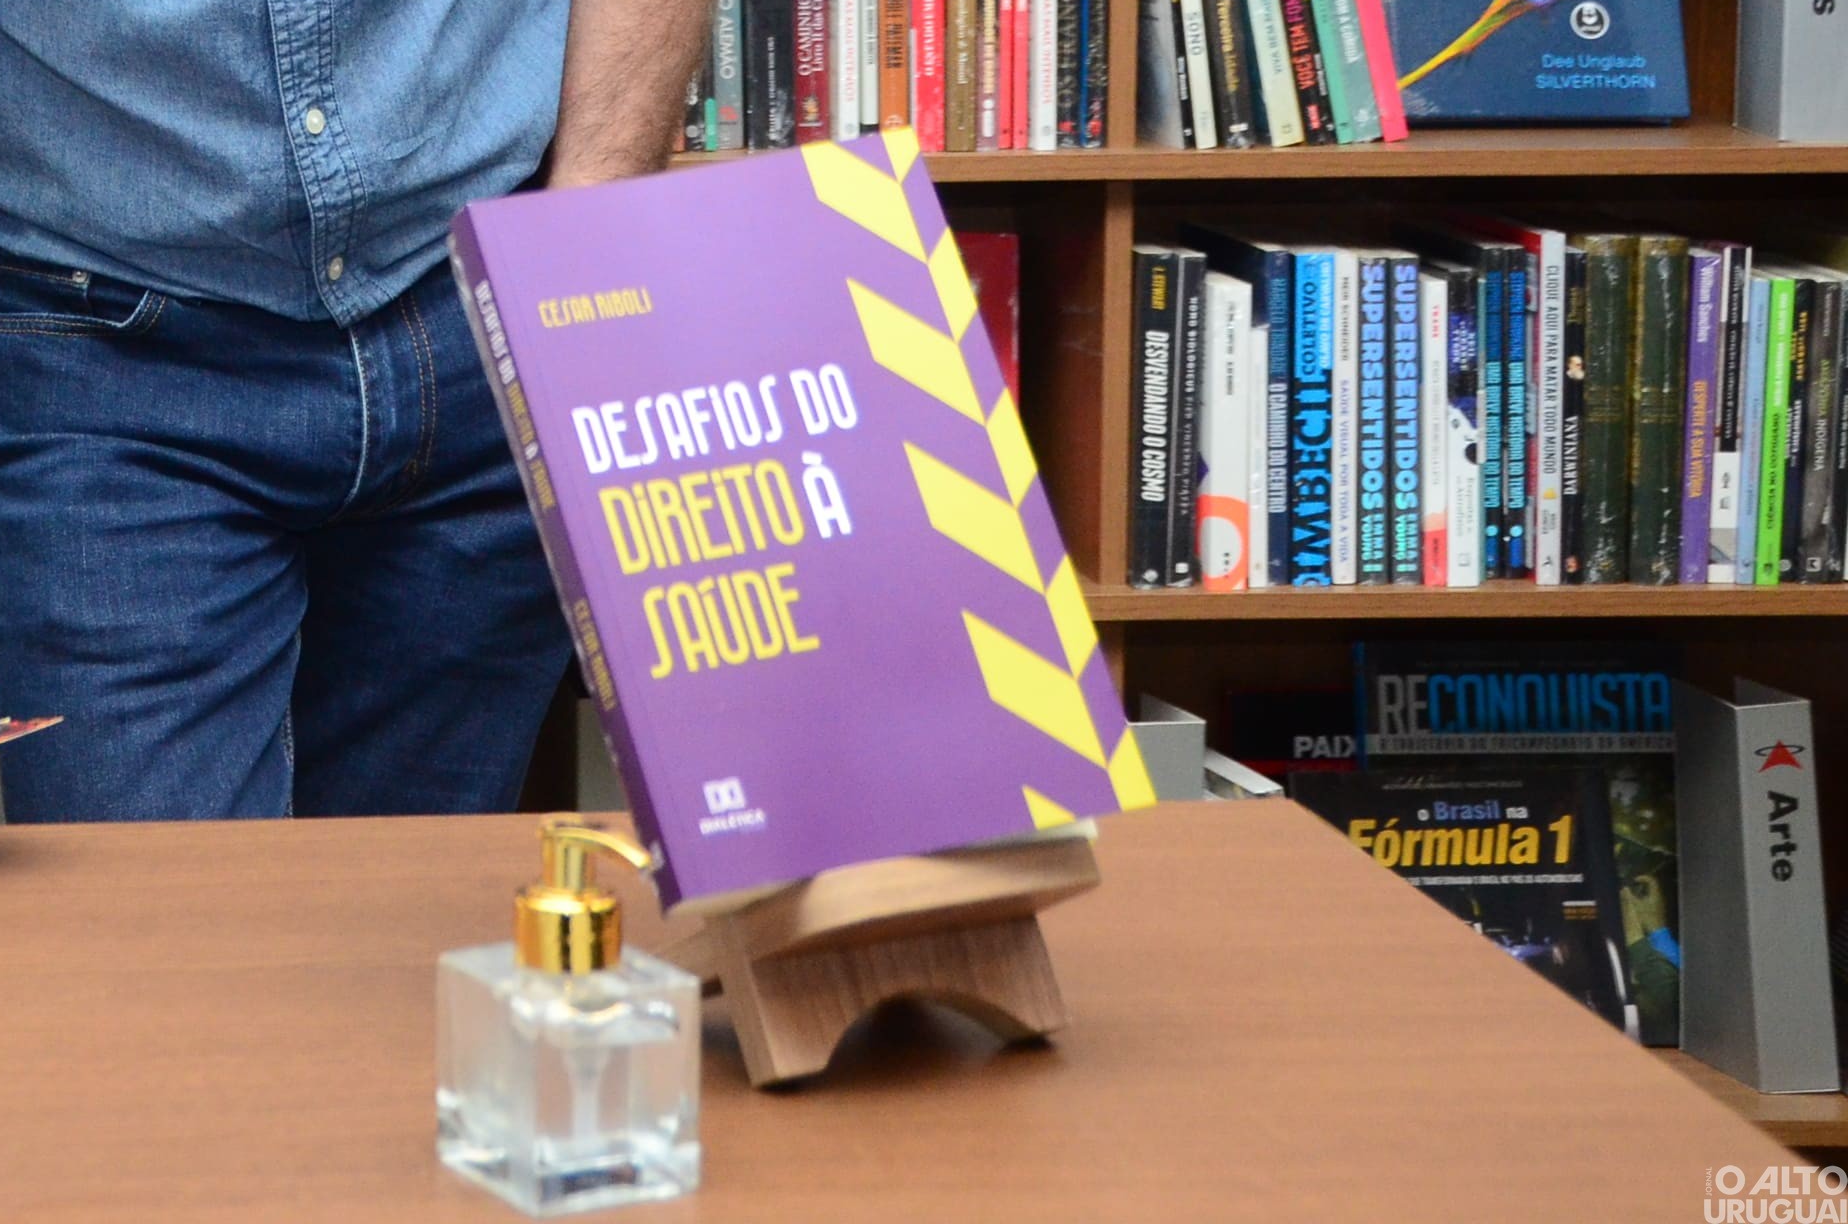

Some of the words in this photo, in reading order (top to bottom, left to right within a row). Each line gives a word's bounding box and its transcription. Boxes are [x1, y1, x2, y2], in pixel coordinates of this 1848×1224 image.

[1535, 74, 1656, 91] SILVERTHORN
[1542, 54, 1574, 69] Dee
[1577, 53, 1646, 72] Unglaub
[1545, 264, 1559, 302] CLIQUE
[538, 295, 594, 328] CESAR
[595, 286, 653, 321] RIBOLI
[1300, 281, 1318, 376] COLETIVO
[1544, 305, 1558, 332] AQUI
[1543, 333, 1558, 364] PARA
[1143, 329, 1170, 435] DESVENDANDO
[1269, 382, 1286, 391] O
[1361, 264, 1386, 510] SUPERSENTIDOS
[1394, 264, 1418, 510] SUPERSENTIDOS
[1508, 361, 1525, 384] UMA
[1543, 365, 1557, 402] MATAR
[570, 374, 784, 476] DESAFIOS
[788, 362, 858, 438] DO
[1269, 392, 1286, 448] CAMINHO
[1508, 384, 1525, 414] BREVE
[1543, 404, 1557, 434] TODO
[1141, 435, 1163, 446] O
[1269, 450, 1286, 465] DO
[1508, 414, 1524, 460] HISTÓRIA
[1542, 435, 1557, 474] MUNDO
[1563, 415, 1579, 496] DARWINIANA
[1140, 448, 1166, 503] COSMO
[1268, 466, 1286, 514] CENTRO
[1508, 461, 1524, 476] DO
[599, 458, 805, 575] DIREITO
[802, 451, 853, 539] À
[1508, 476, 1524, 509] TEMPO
[1361, 514, 1373, 561] YOUNG
[1373, 512, 1385, 559] EMMA
[1394, 514, 1406, 561] YOUNG
[1406, 512, 1417, 559] EMMA
[642, 562, 820, 680] SAÚDE
[1375, 673, 1674, 736] RECONQUISTA
[1417, 808, 1430, 822] o
[1433, 800, 1501, 821] Brasil
[1505, 805, 1528, 820] na
[1347, 816, 1540, 869] Fórmula
[1548, 815, 1574, 864] 1
[1766, 789, 1802, 883] Arte
